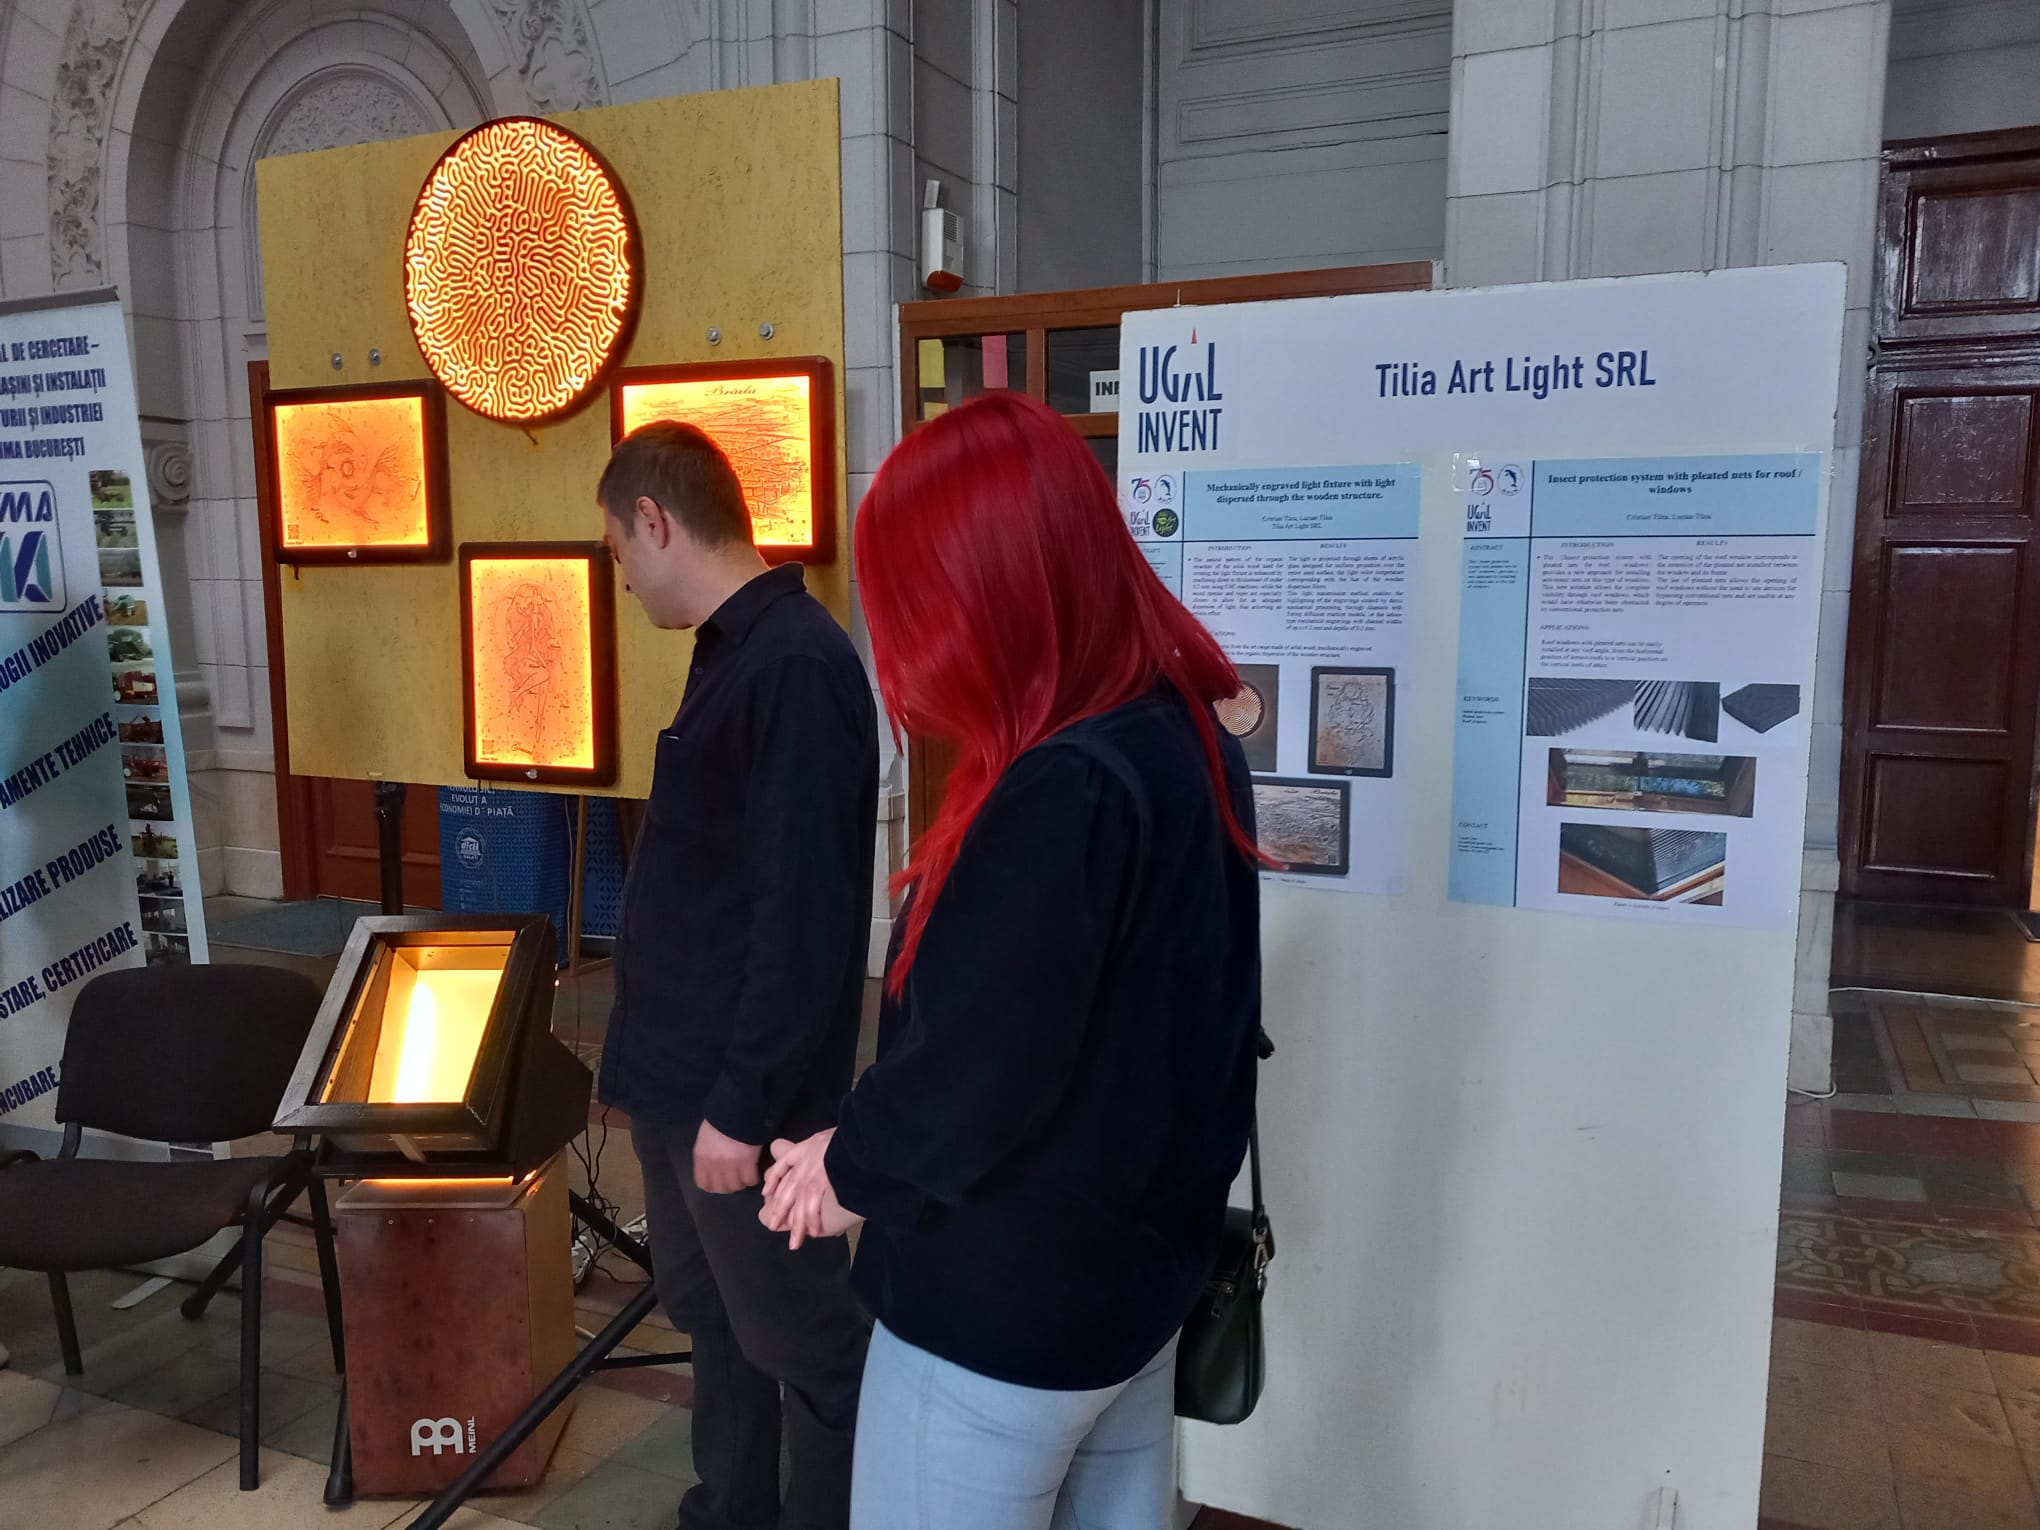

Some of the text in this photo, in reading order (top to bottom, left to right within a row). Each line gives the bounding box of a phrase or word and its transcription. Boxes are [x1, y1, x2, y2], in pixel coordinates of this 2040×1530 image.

[11, 342, 26, 361] DE
[28, 335, 90, 360] CERCETARE
[32, 373, 44, 398] ȘI
[45, 368, 106, 394] INSTALAȚII
[1376, 350, 1656, 400] Tilia Art Light SRL
[28, 407, 39, 431] ȘI
[40, 402, 103, 425] INDUSTRIEI
[1138, 408, 1222, 453] INVENT
[25, 437, 85, 462] BUCUREȘTI
[1207, 478, 1395, 493] Mechanically engraved light fixture with light
[1470, 468, 1494, 496] 75
[1548, 474, 1577, 483] Insect
[1579, 474, 1628, 484] protection
[1631, 473, 1664, 483] system
[1666, 472, 1689, 481] with
[1691, 471, 1728, 482] pleated
[1731, 471, 1752, 480] nets
[1754, 470, 1772, 479] for
[1774, 469, 1797, 478] roof
[1649, 485, 1692, 494] windows
[1216, 492, 1383, 504] dispersed through the wooden structure.
[1467, 520, 1491, 532] INVENT
[28, 594, 104, 668] INOVATIVE
[54, 712, 118, 771] TEHNICE
[451, 794, 487, 805] EVOLUȚA
[487, 806, 514, 818] PIAȚĂ
[46, 823, 123, 889] PRODUSE
[41, 921, 138, 993] CERTIFICARE
[466, 1416, 477, 1453] MEINL
